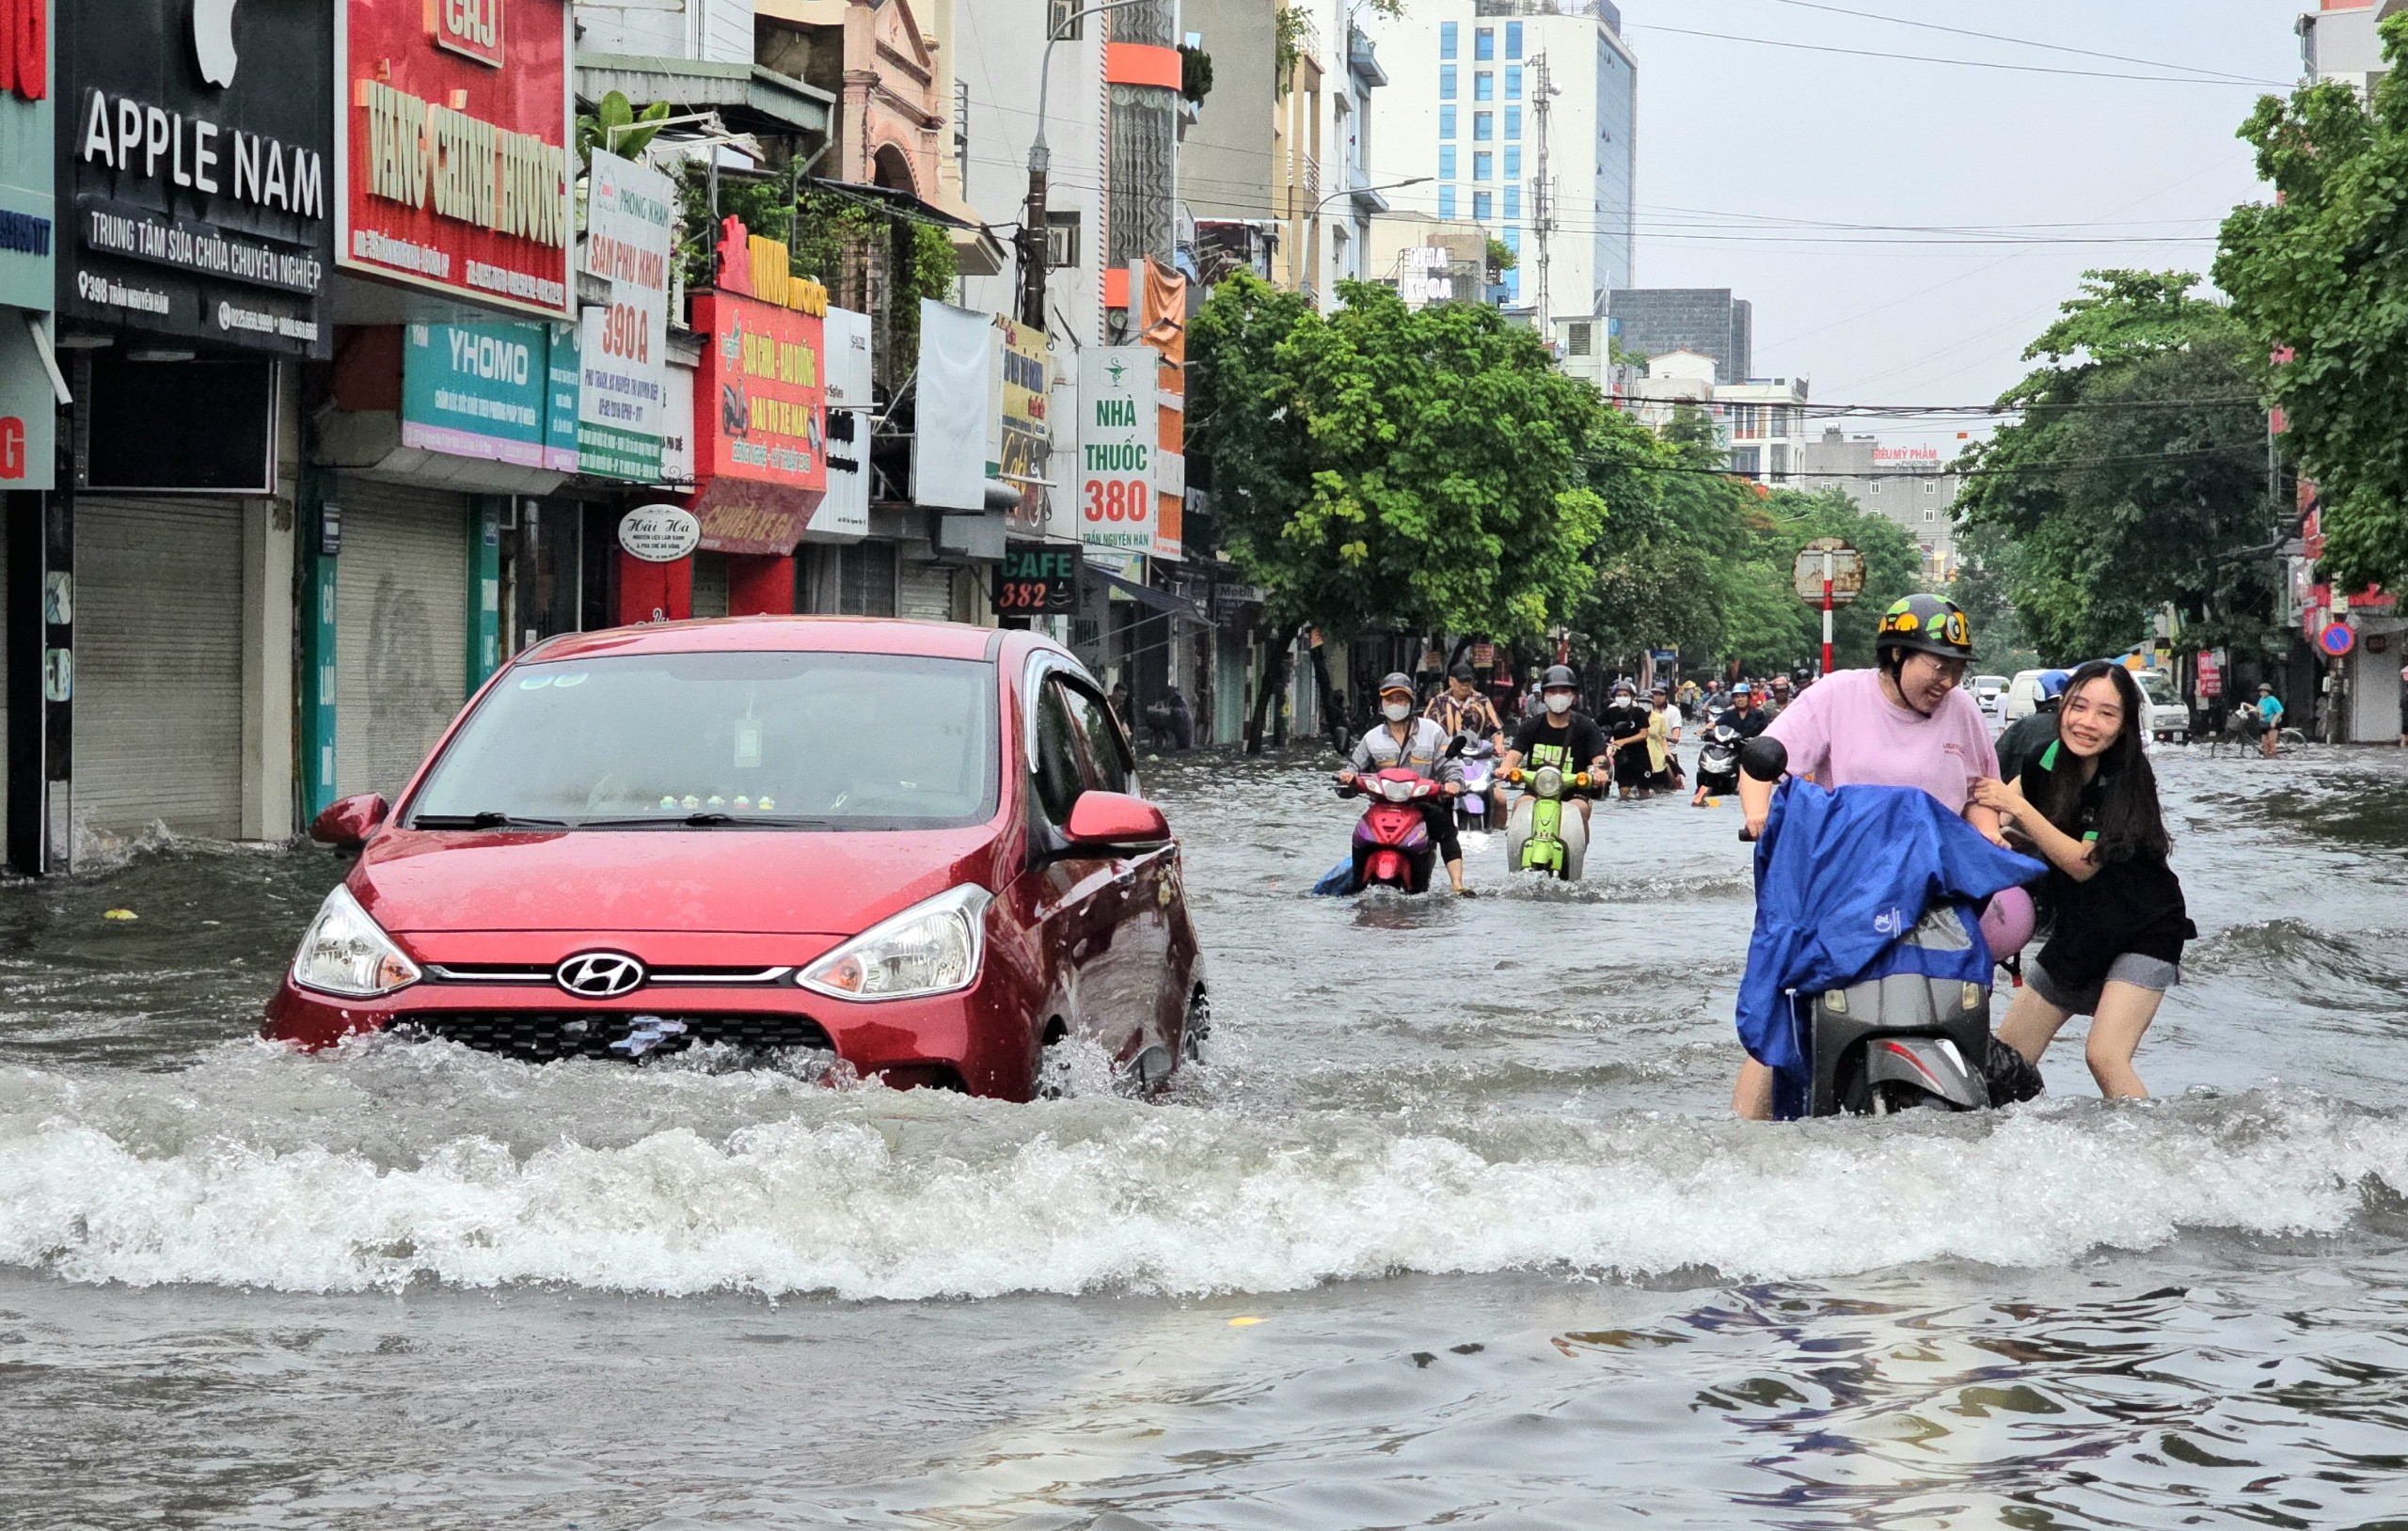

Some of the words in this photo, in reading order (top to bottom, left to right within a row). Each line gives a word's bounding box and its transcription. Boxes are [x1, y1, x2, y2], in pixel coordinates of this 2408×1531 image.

[85, 89, 218, 194] APPLE
[234, 130, 323, 220] NAM
[368, 58, 427, 211] VÀNG
[432, 89, 497, 227] CHÍNH
[90, 211, 135, 251] TRUNG
[137, 217, 166, 259] TÂM
[167, 221, 193, 264] SỬA
[196, 232, 229, 272] CHỮA
[231, 245, 277, 281] CHUYÊN
[279, 254, 322, 291] NGHIỆP
[591, 225, 614, 277] SẢN
[614, 241, 636, 291] PHỤ
[638, 248, 663, 292] KHOA
[1411, 246, 1448, 269] NHA
[1403, 277, 1453, 300] KHOA
[448, 327, 529, 386] YHOMO
[1096, 394, 1137, 428] NHÀ
[1085, 434, 1149, 471] THUỐC
[1084, 480, 1148, 523] 380
[999, 552, 1075, 579] CAFE
[999, 582, 1047, 608] 382
